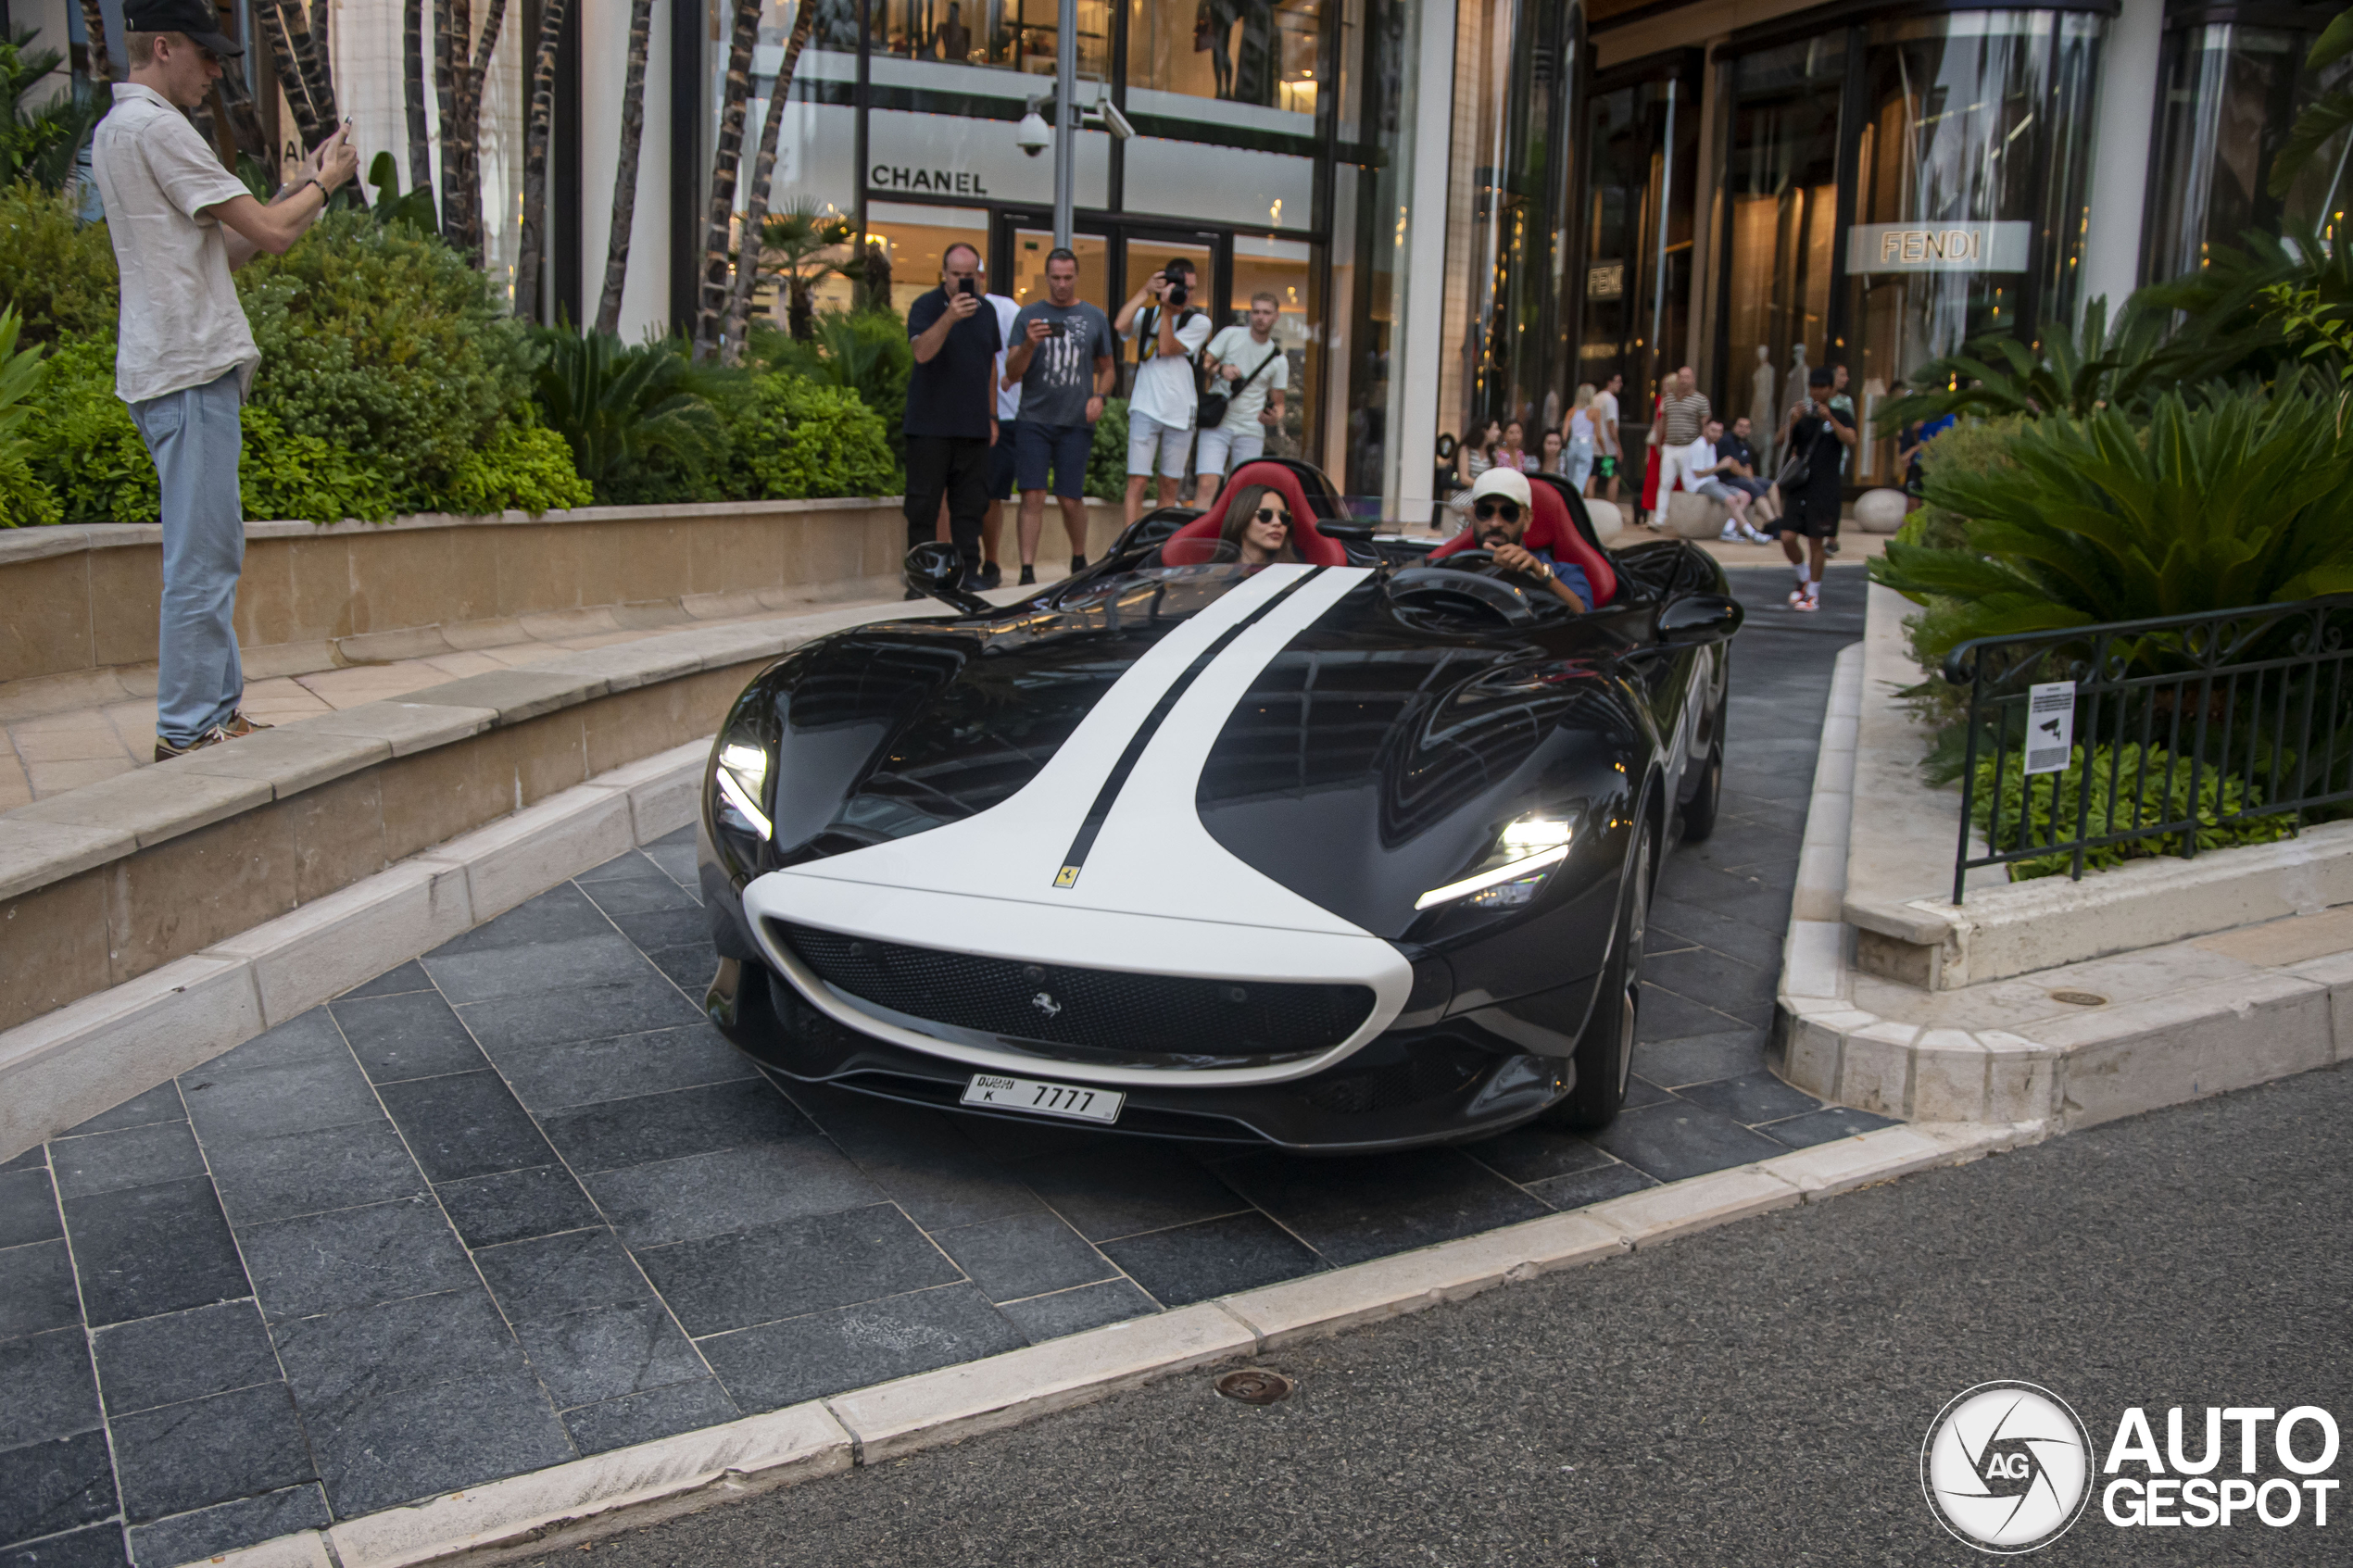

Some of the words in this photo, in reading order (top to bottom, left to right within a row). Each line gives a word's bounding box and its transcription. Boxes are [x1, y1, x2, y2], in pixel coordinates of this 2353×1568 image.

[872, 165, 988, 194] CHANEL
[1881, 230, 1981, 263] FENDI
[983, 1090, 995, 1101] K
[1032, 1085, 1096, 1111] 7777
